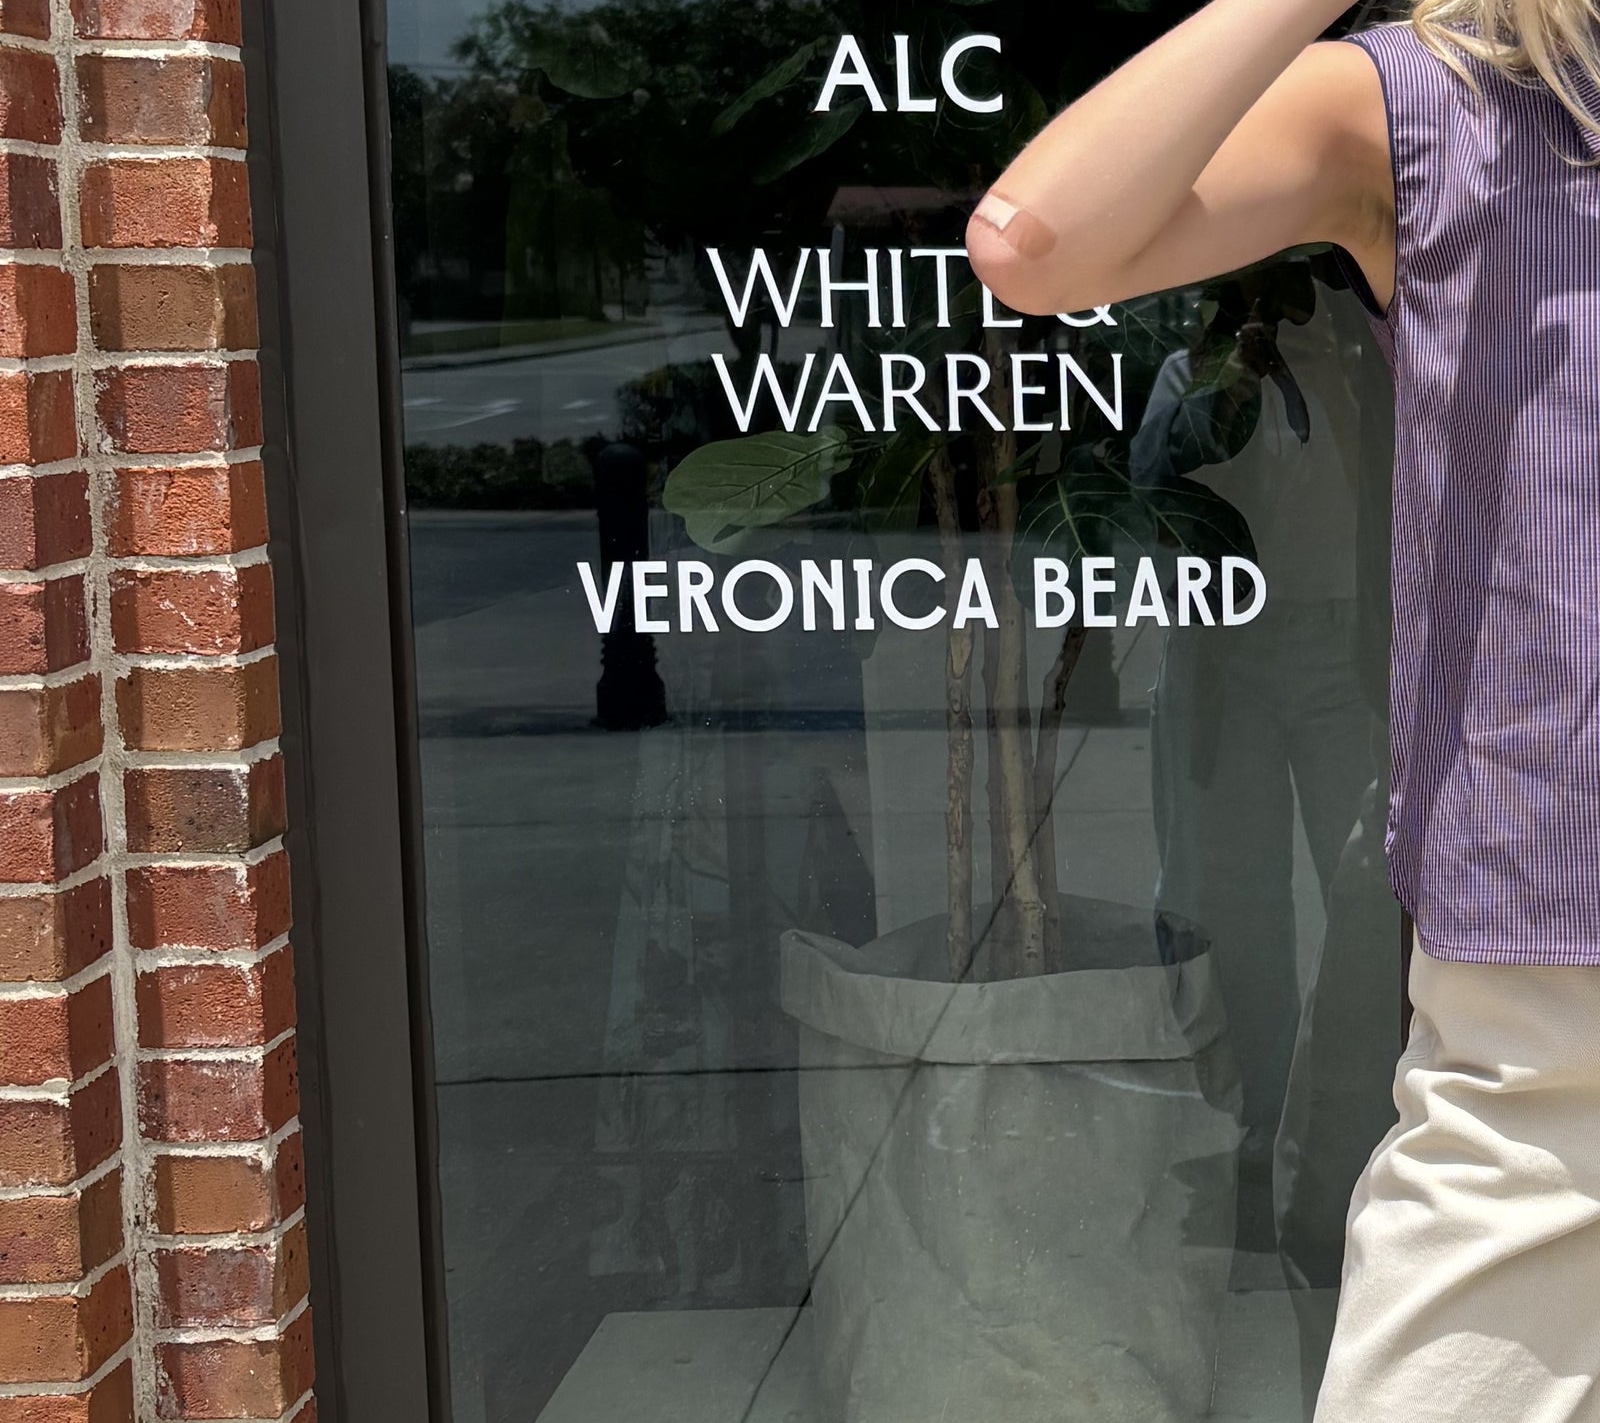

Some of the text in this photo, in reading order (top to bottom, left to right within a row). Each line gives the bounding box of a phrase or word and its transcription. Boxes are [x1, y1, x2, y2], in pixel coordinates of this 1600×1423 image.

[814, 34, 1003, 113] ALC
[711, 353, 1123, 432] WARREN
[576, 556, 1267, 634] VERONICA BEARD
